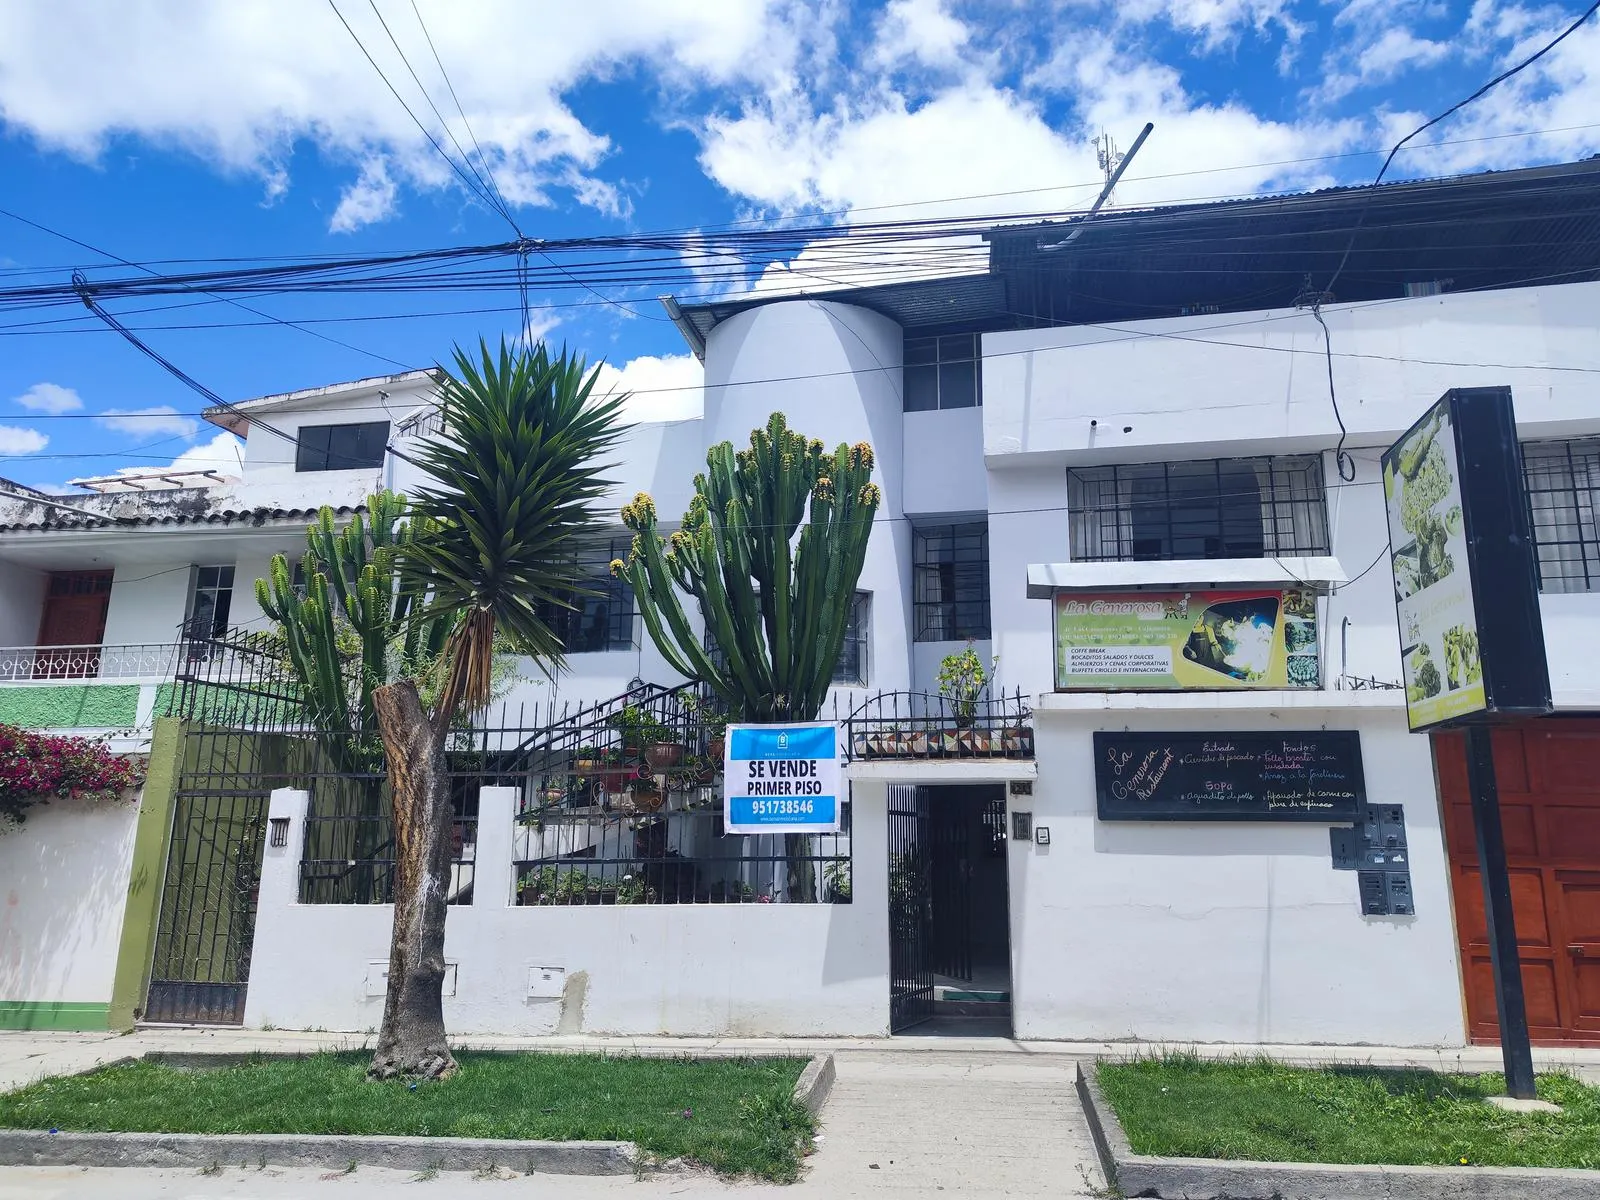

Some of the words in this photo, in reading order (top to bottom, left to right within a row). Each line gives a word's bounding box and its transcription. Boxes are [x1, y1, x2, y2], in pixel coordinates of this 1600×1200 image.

[1063, 600, 1087, 615] La
[1090, 600, 1163, 615] Generosa
[749, 760, 765, 778] SE
[769, 760, 817, 778] VENDE
[1108, 747, 1133, 775] La
[1112, 749, 1159, 800] Generosa
[747, 781, 791, 796] PRIMER
[795, 780, 822, 795] PISO
[752, 799, 814, 815] 951738546
